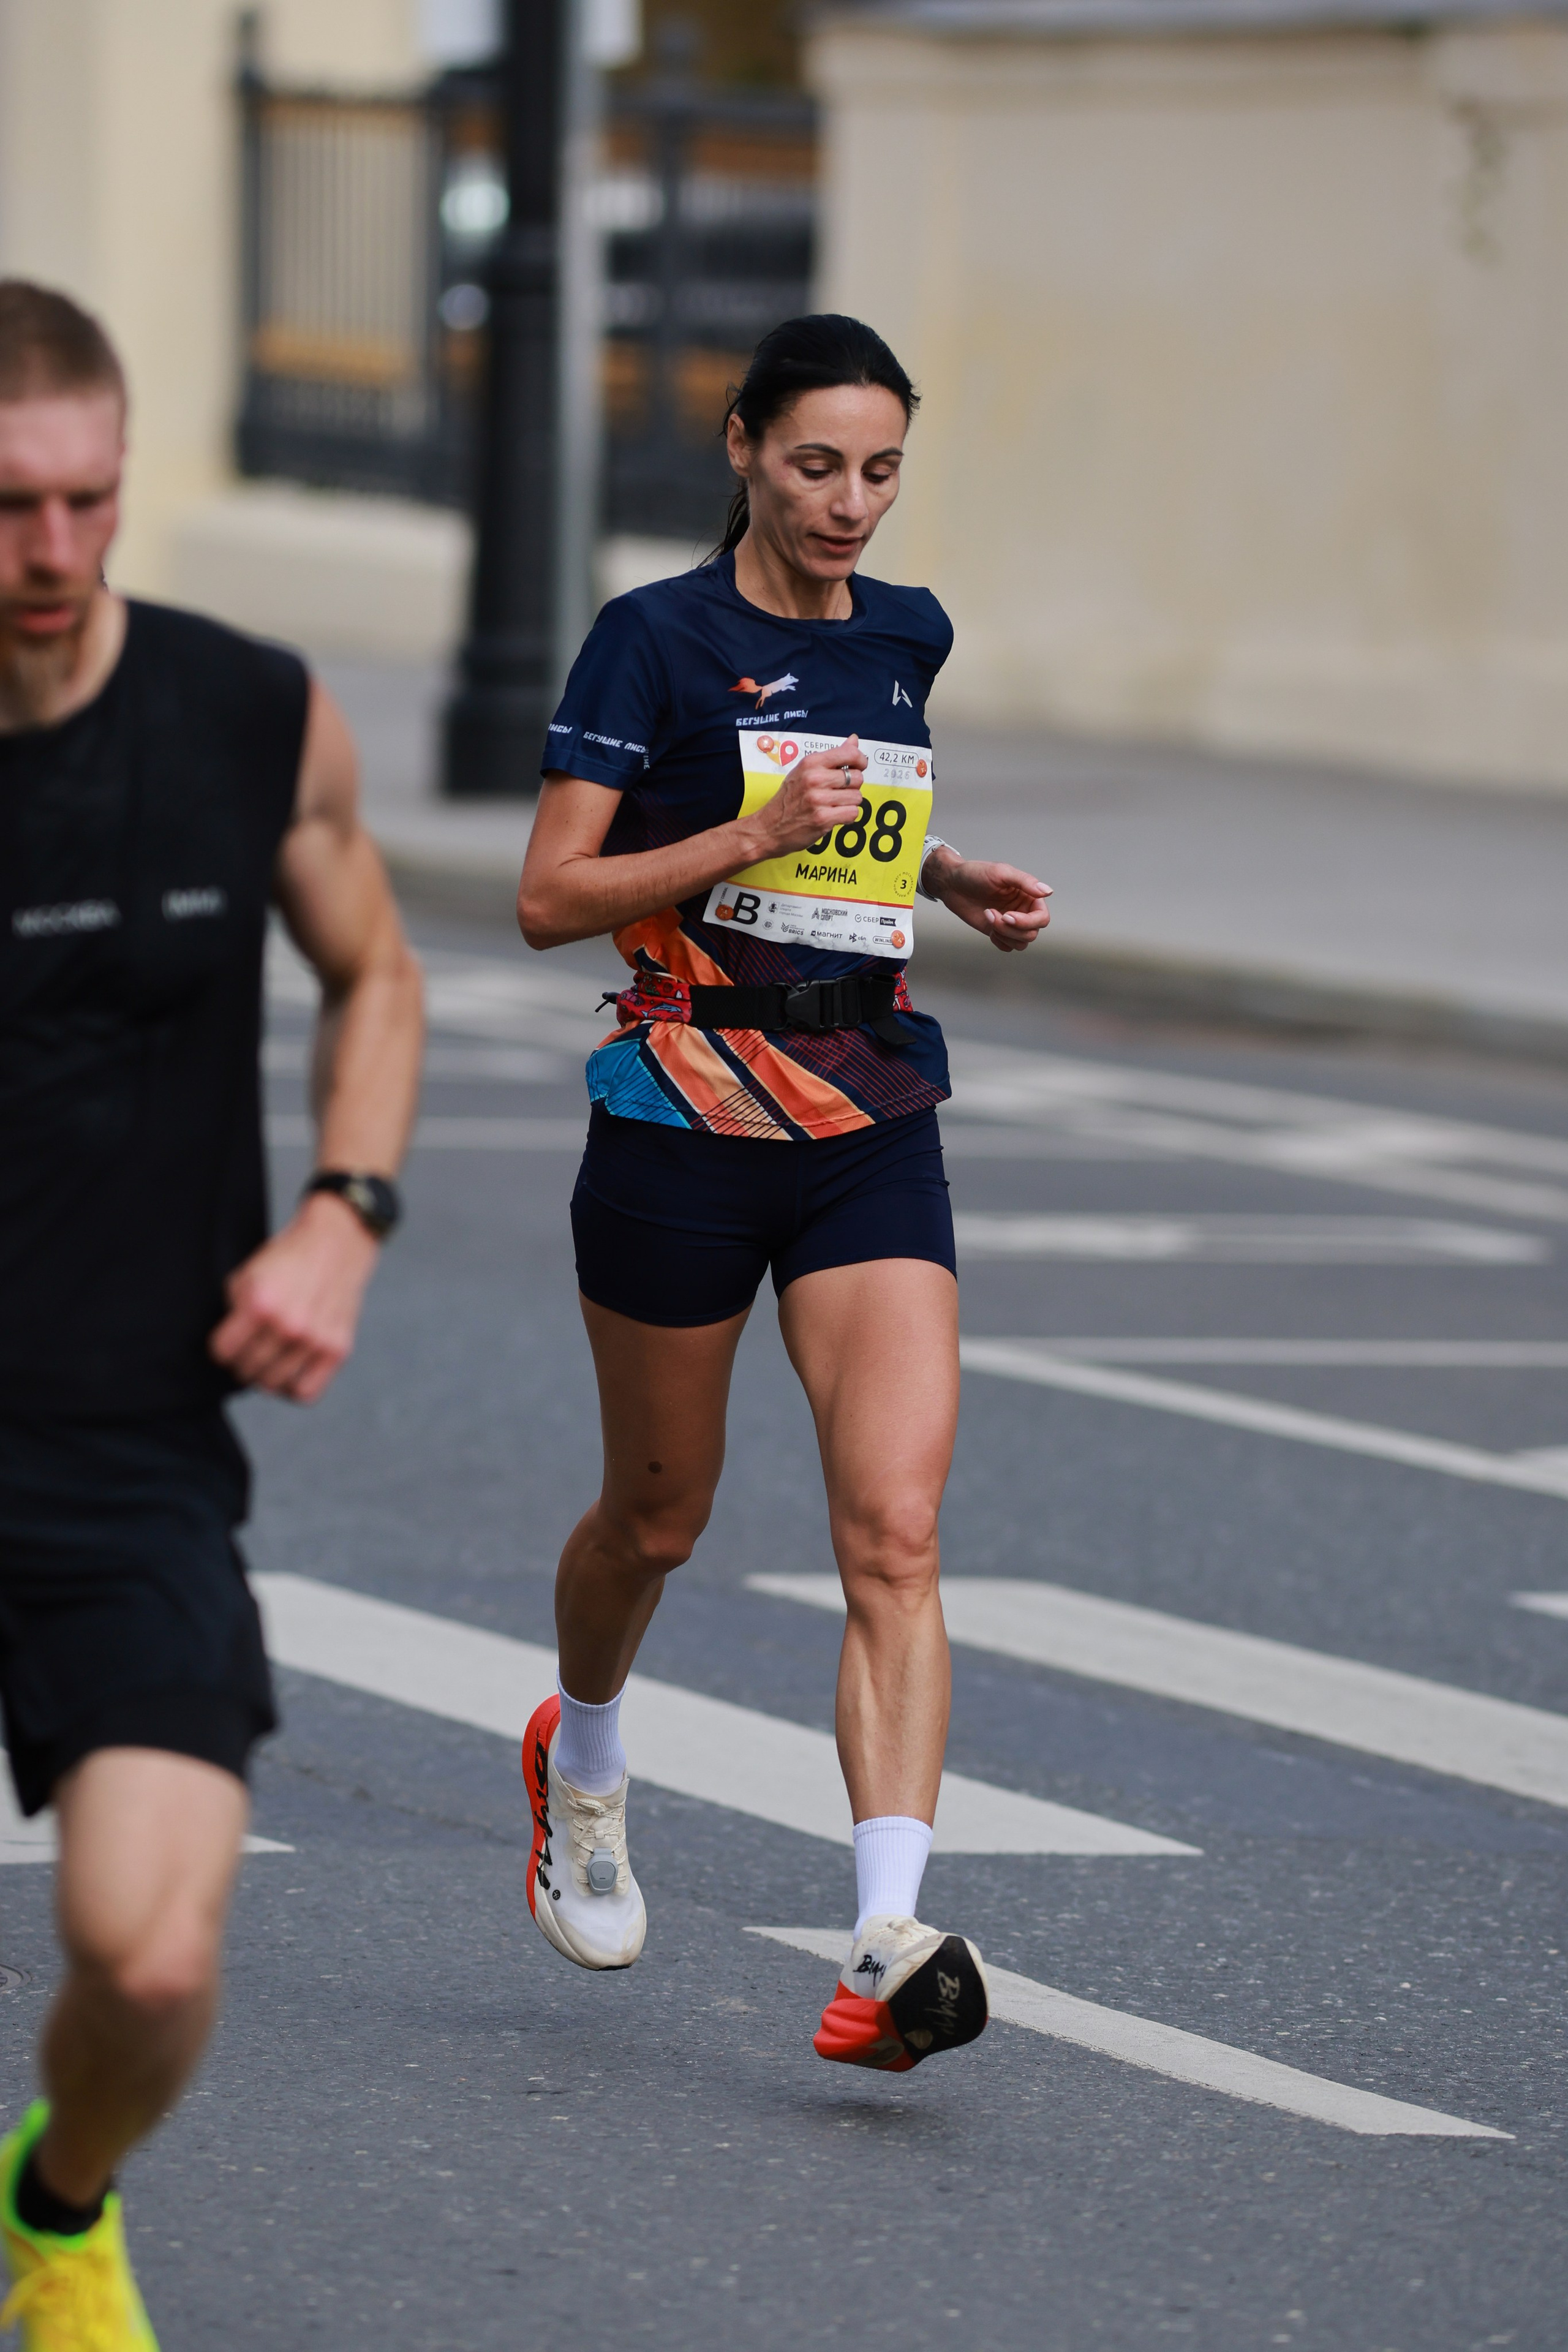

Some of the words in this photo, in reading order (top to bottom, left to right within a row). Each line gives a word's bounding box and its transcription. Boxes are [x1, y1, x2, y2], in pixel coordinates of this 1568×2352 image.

[736, 713, 780, 726] БЕГУЩИЕ
[784, 710, 809, 720] ЛИСЫ
[583, 731, 623, 748] БЕГУЩИЕ
[880, 752, 898, 763] 42,2
[902, 755, 914, 764] КМ
[795, 863, 858, 885] МАРИНА
[900, 879, 907, 889] 3
[732, 891, 761, 925] B
[821, 908, 848, 916] МОСКОВСКИЙ
[863, 915, 879, 924] СБЕР
[816, 930, 843, 939] магнит
